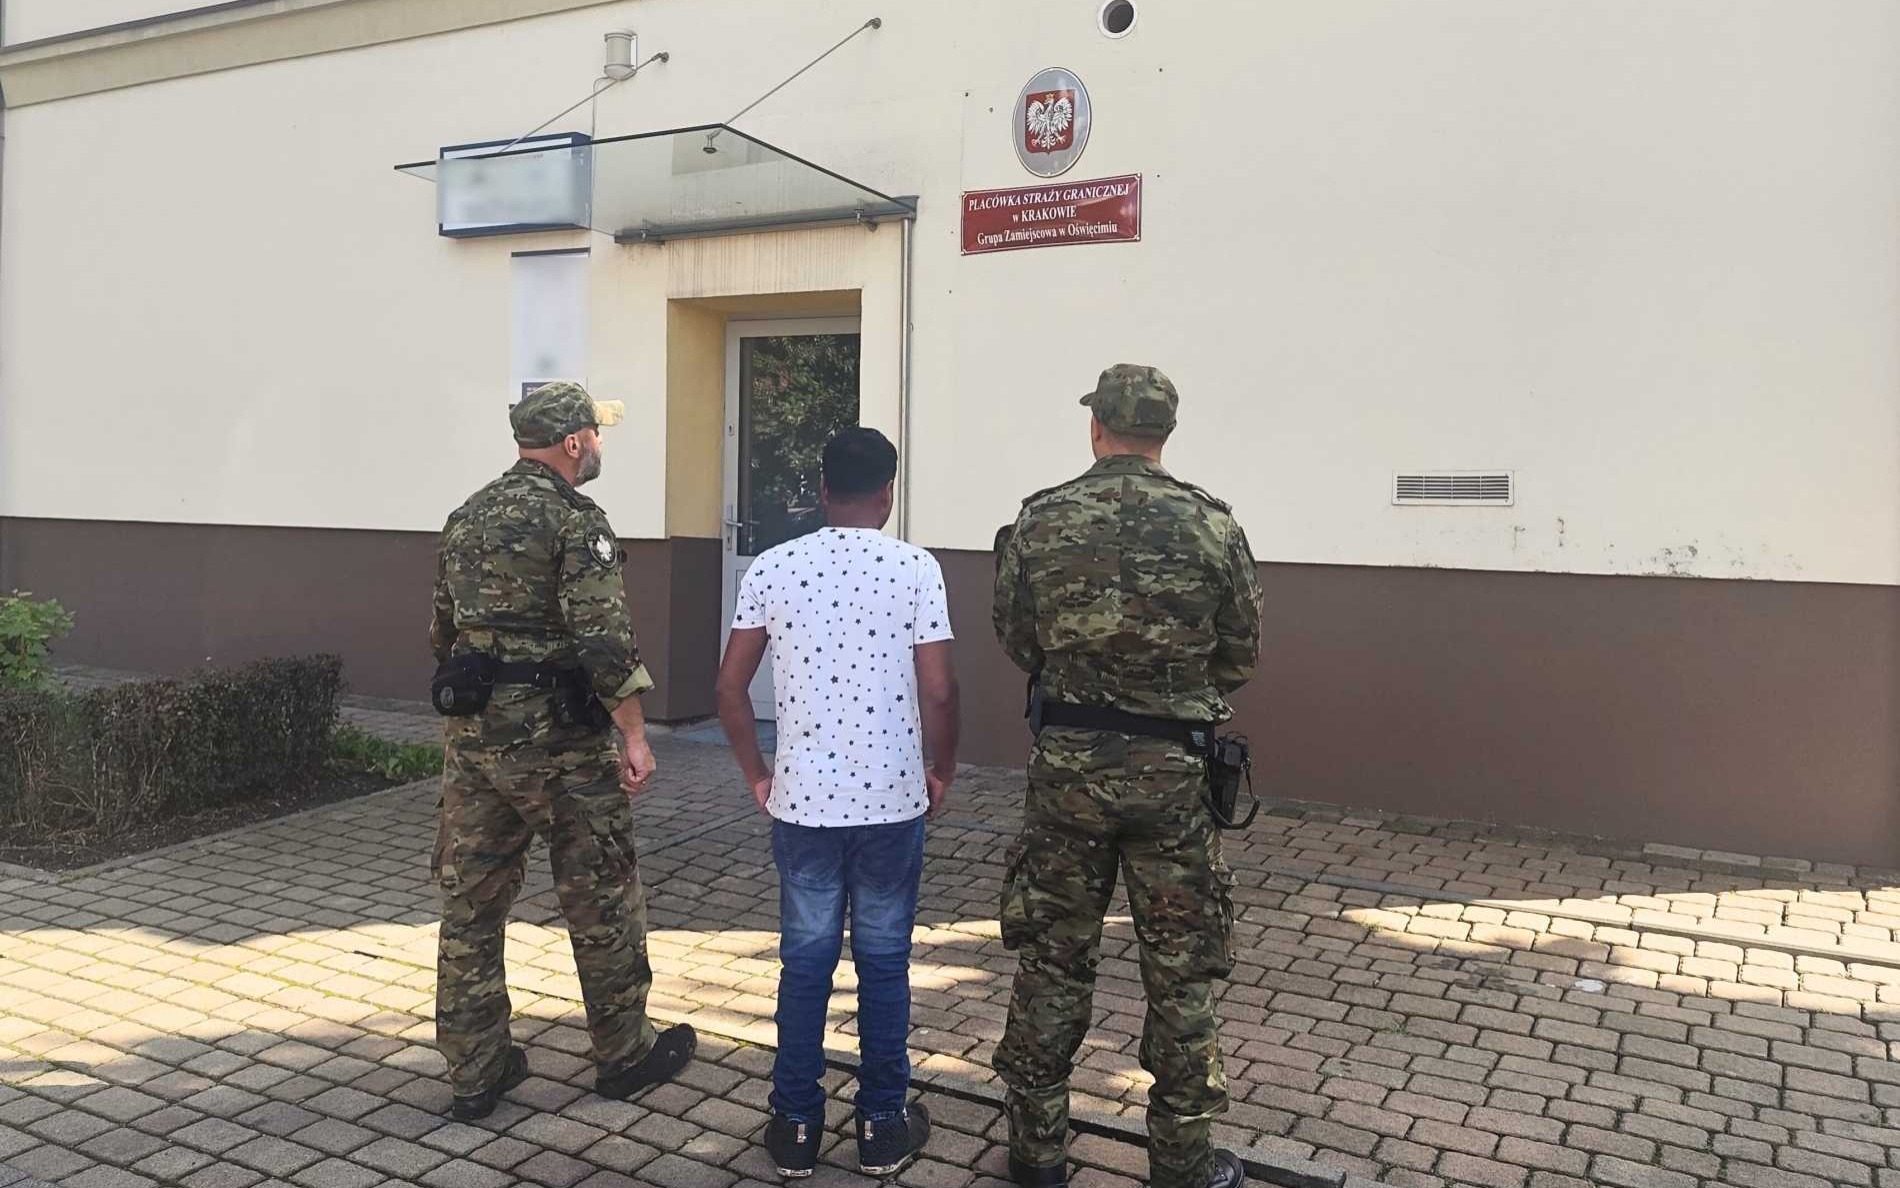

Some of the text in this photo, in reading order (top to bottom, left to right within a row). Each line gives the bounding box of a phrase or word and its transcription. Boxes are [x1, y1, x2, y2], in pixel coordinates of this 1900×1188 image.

[968, 183, 1129, 211] PLACÓWKA STRAŻY GRANICZNEJ
[1012, 205, 1077, 223] w KRAKOWIE
[977, 220, 1118, 246] Grupa Zamiejscowa w Oświęcimiu
